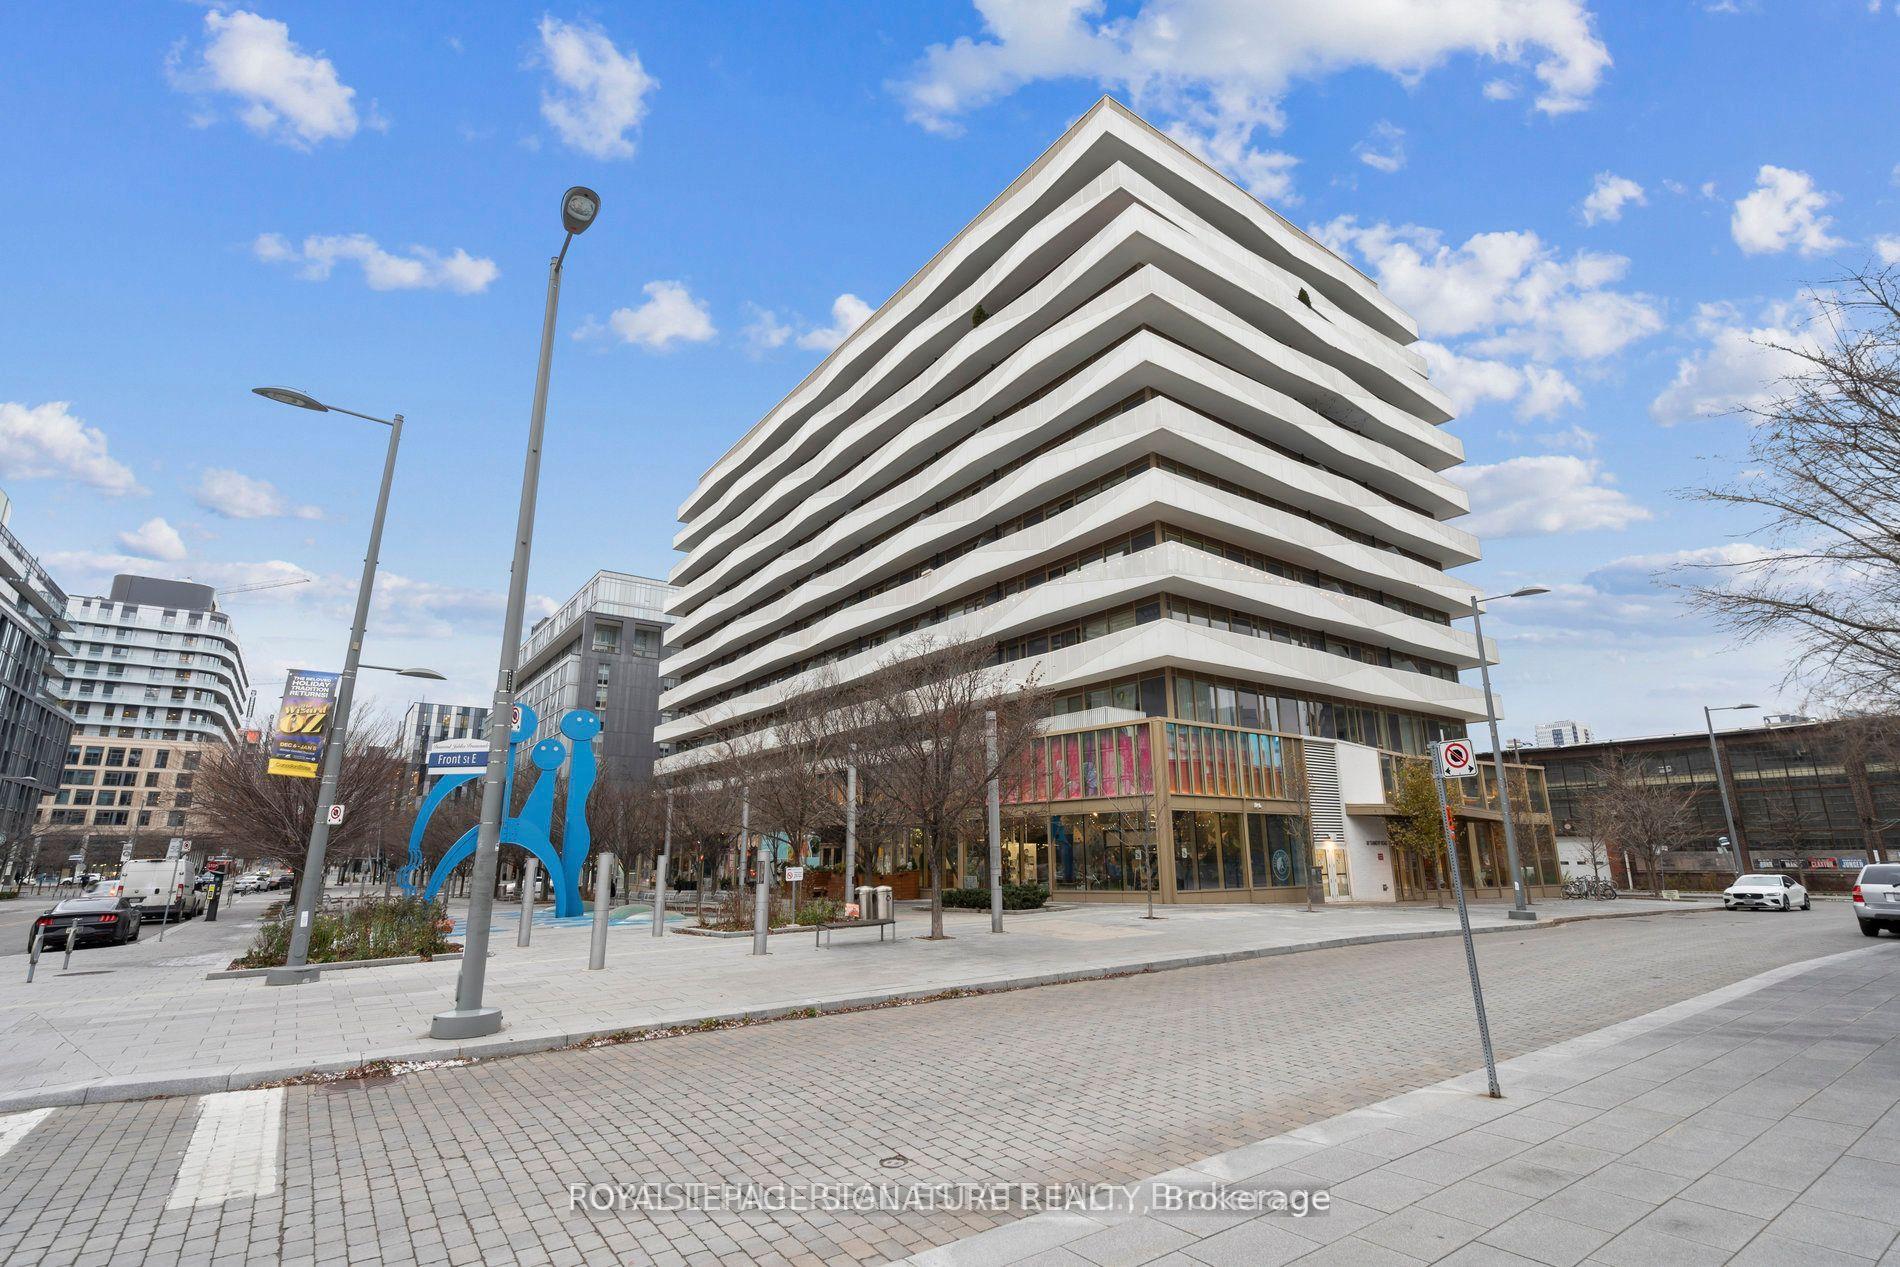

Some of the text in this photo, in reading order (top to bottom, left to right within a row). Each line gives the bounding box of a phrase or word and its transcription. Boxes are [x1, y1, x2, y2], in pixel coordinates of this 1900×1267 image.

[289, 690, 329, 698] RETURNS!
[279, 713, 327, 733] OZ
[437, 753, 477, 765] Front St E
